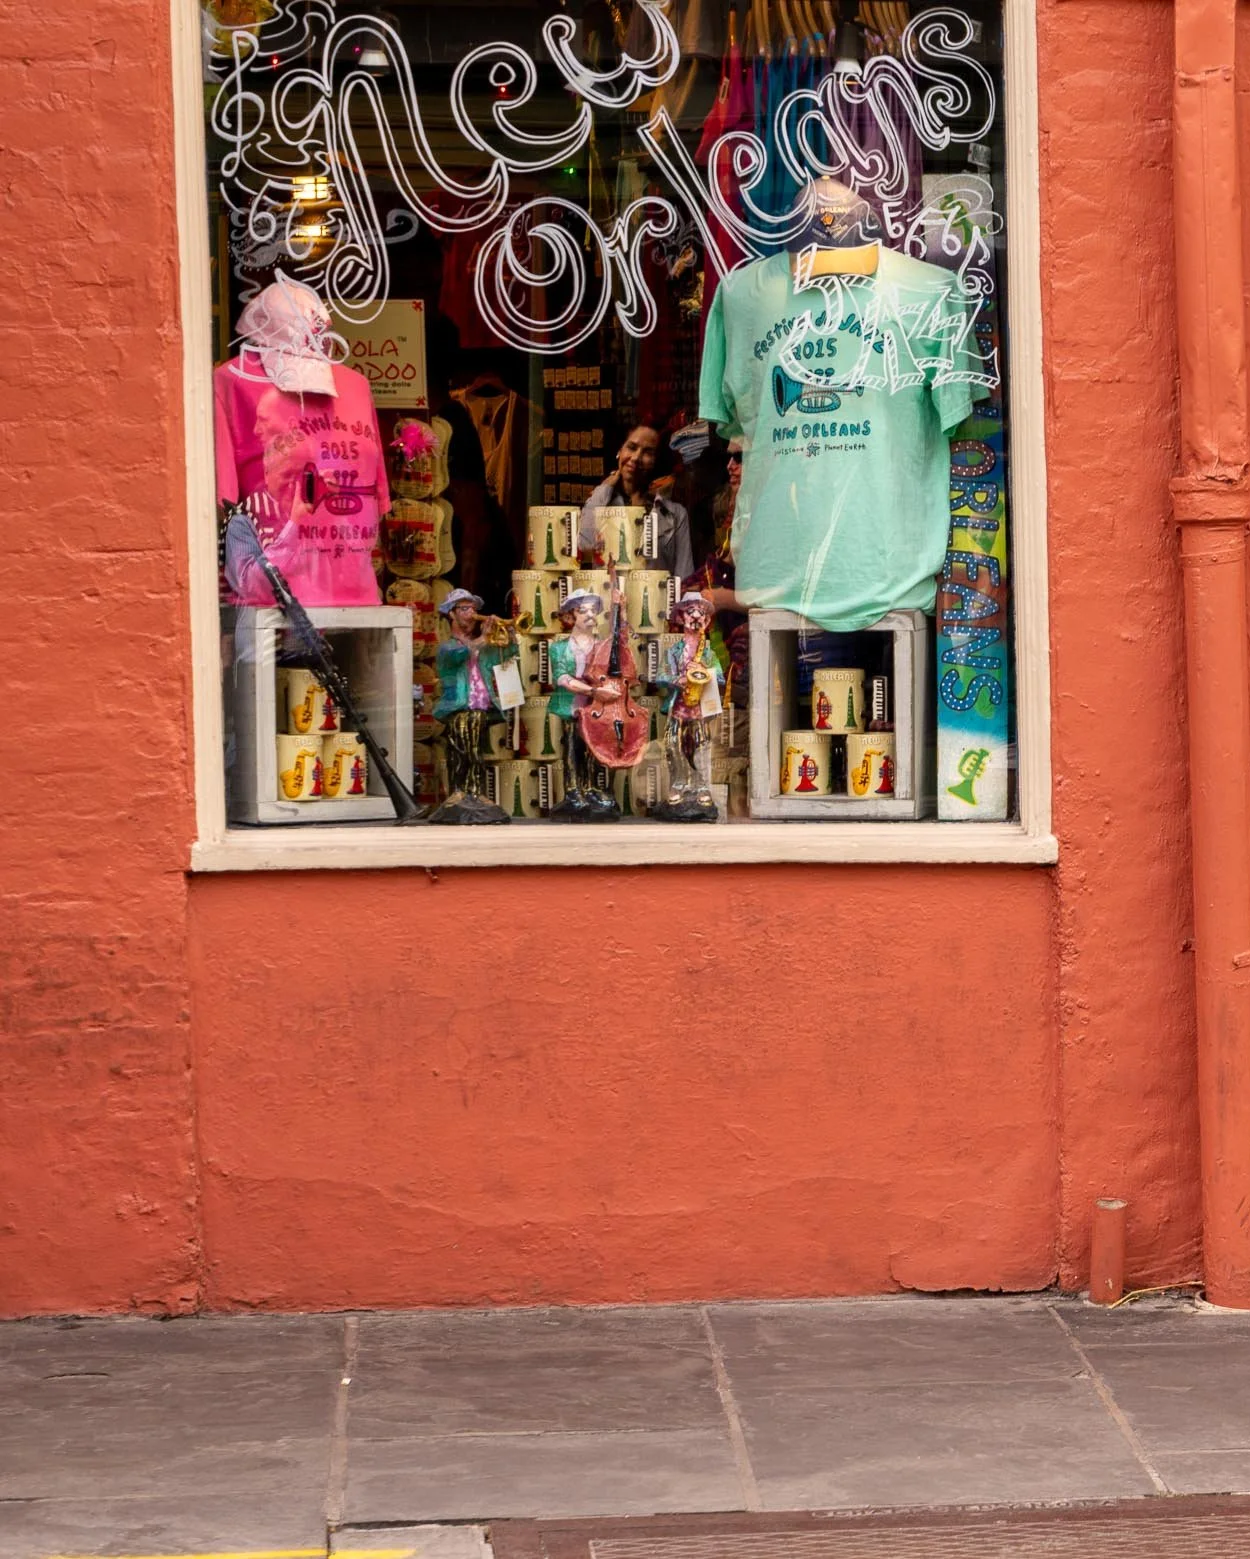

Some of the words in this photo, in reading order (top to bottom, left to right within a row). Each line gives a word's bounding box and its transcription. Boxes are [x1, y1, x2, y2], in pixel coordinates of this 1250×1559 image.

[801, 419, 872, 439] ORLEANS
[320, 440, 360, 460] 2015
[940, 439, 1002, 713] ORLEANS
